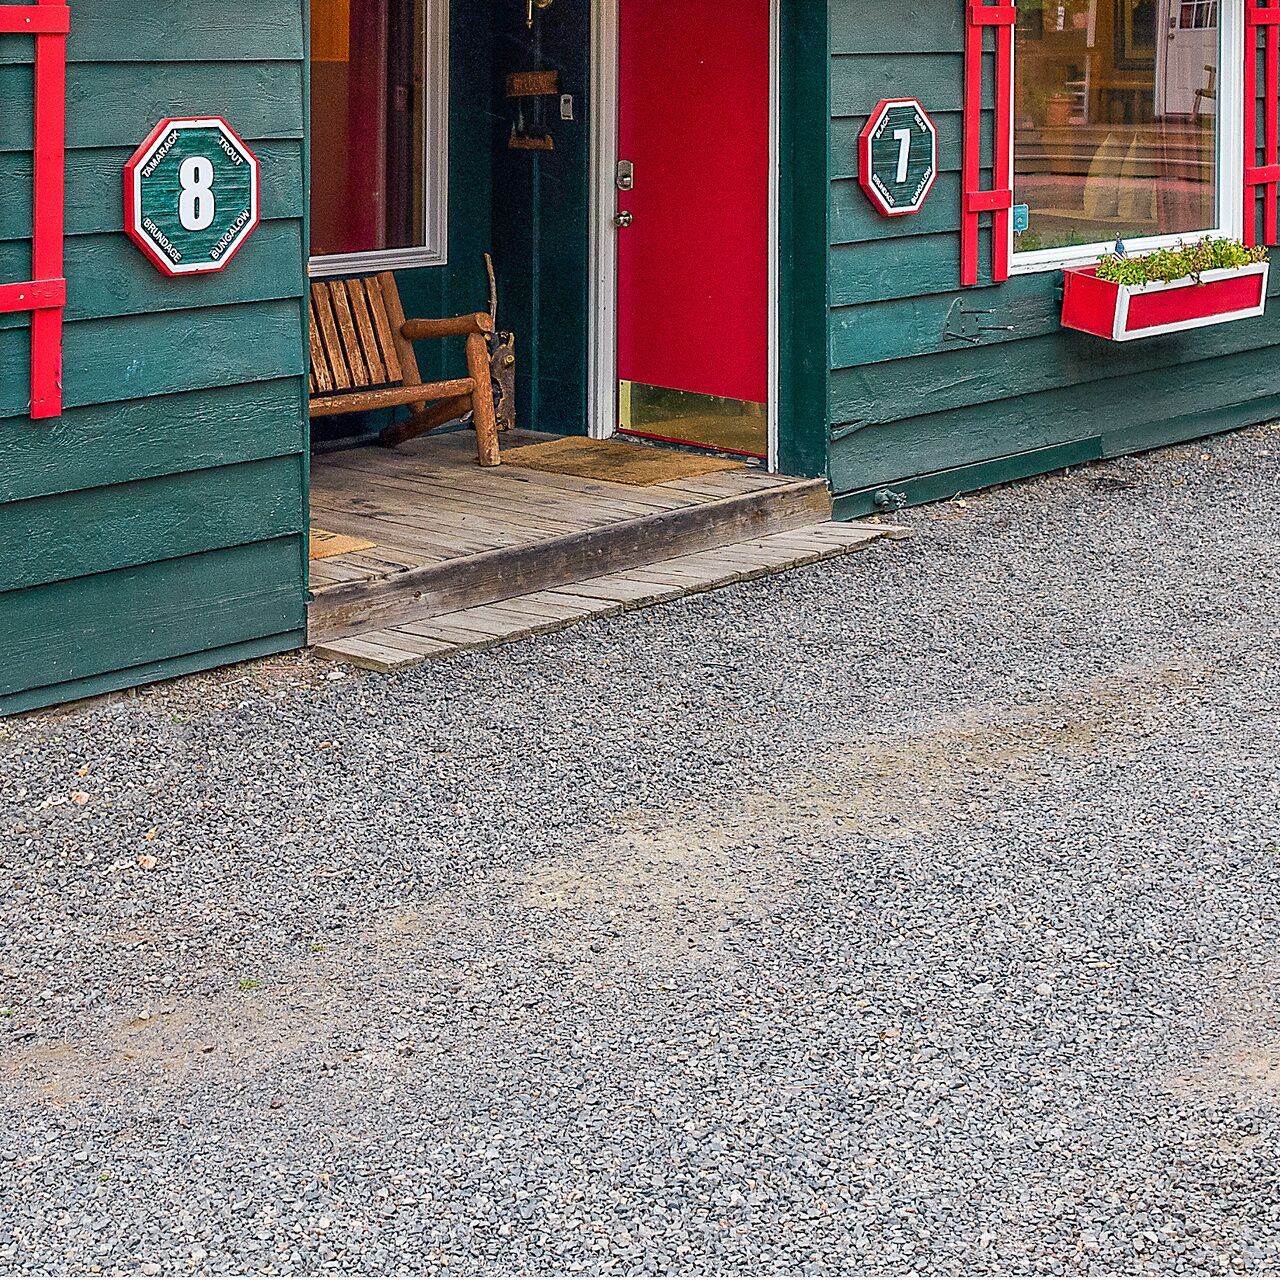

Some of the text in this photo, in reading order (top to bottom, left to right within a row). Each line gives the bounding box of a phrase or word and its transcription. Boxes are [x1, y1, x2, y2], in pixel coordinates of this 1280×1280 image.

[141, 129, 181, 178] TAMARACK
[218, 135, 244, 166] TROUT
[893, 128, 911, 183] 7
[179, 156, 215, 231] 8
[142, 218, 182, 263] BRUNDAGE
[210, 210, 251, 260] BUNGALOW
